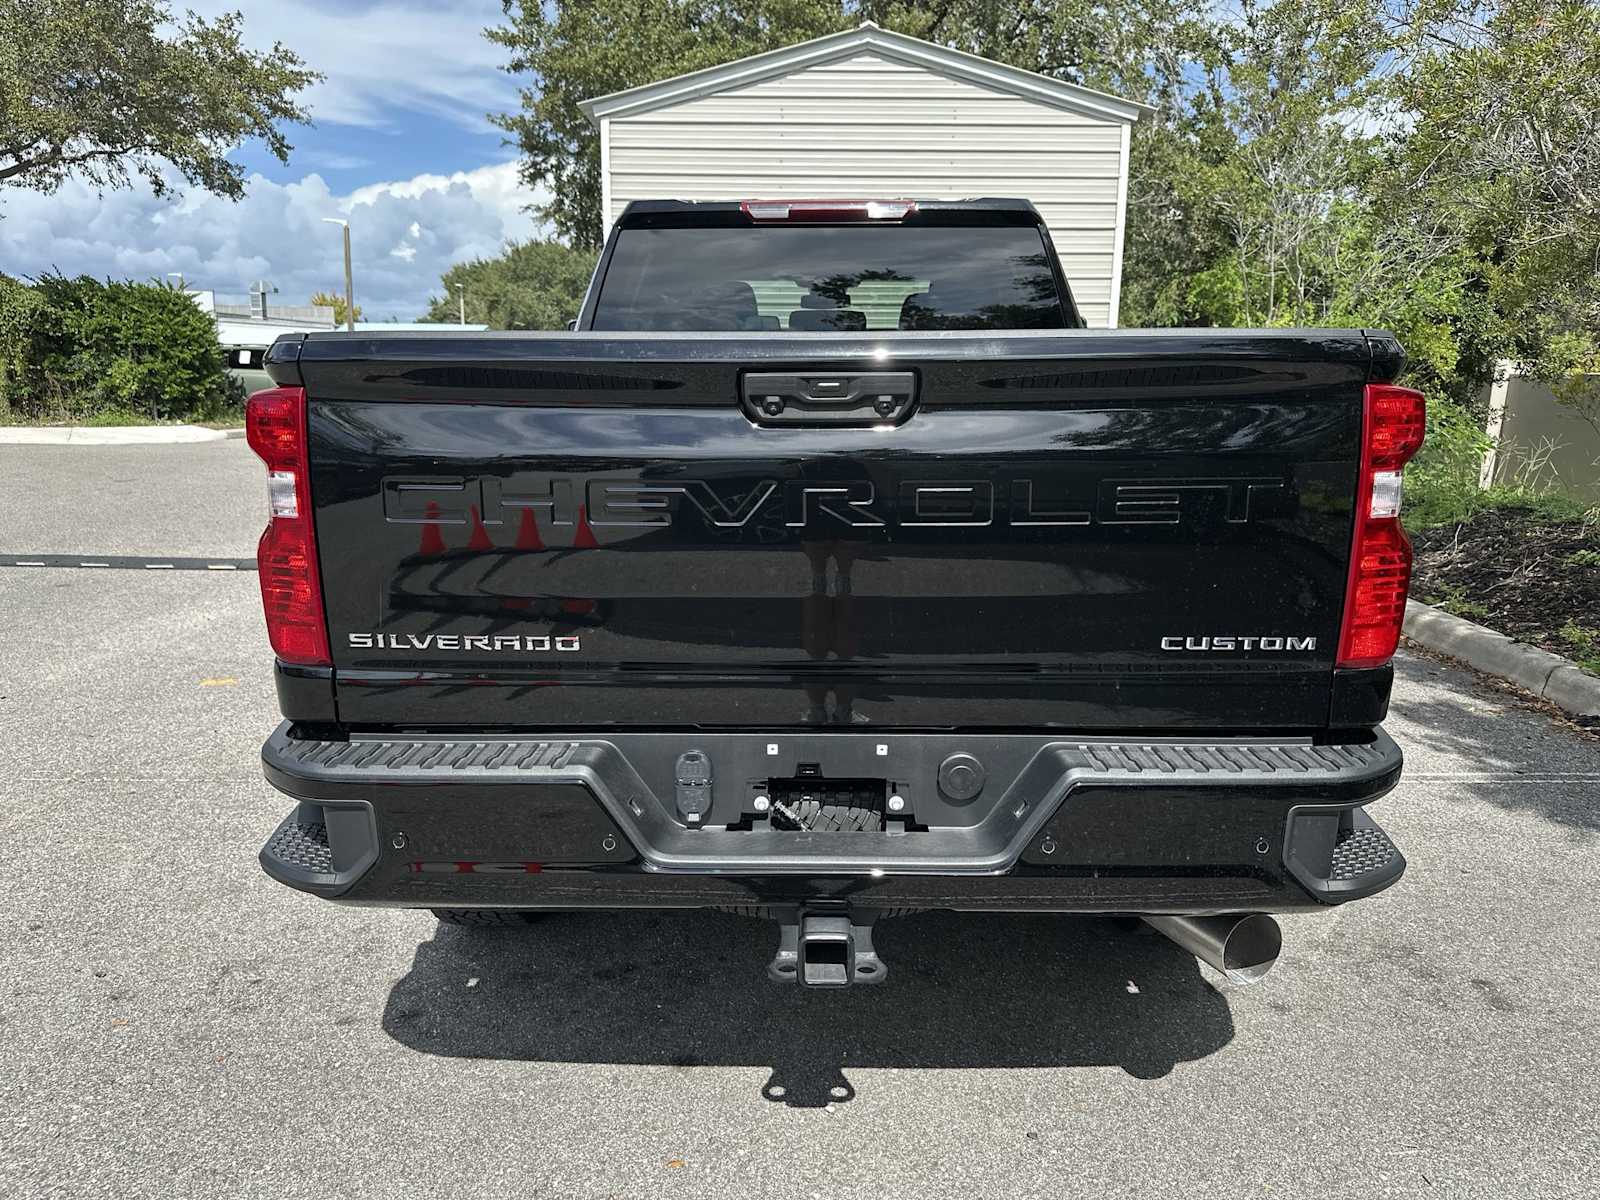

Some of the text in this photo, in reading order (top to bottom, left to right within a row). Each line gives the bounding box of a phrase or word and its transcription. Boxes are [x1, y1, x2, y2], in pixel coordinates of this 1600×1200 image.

[383, 476, 1284, 527] CHEVROLET
[349, 633, 580, 651] SILVERADO
[1161, 636, 1317, 651] CUSTOM
